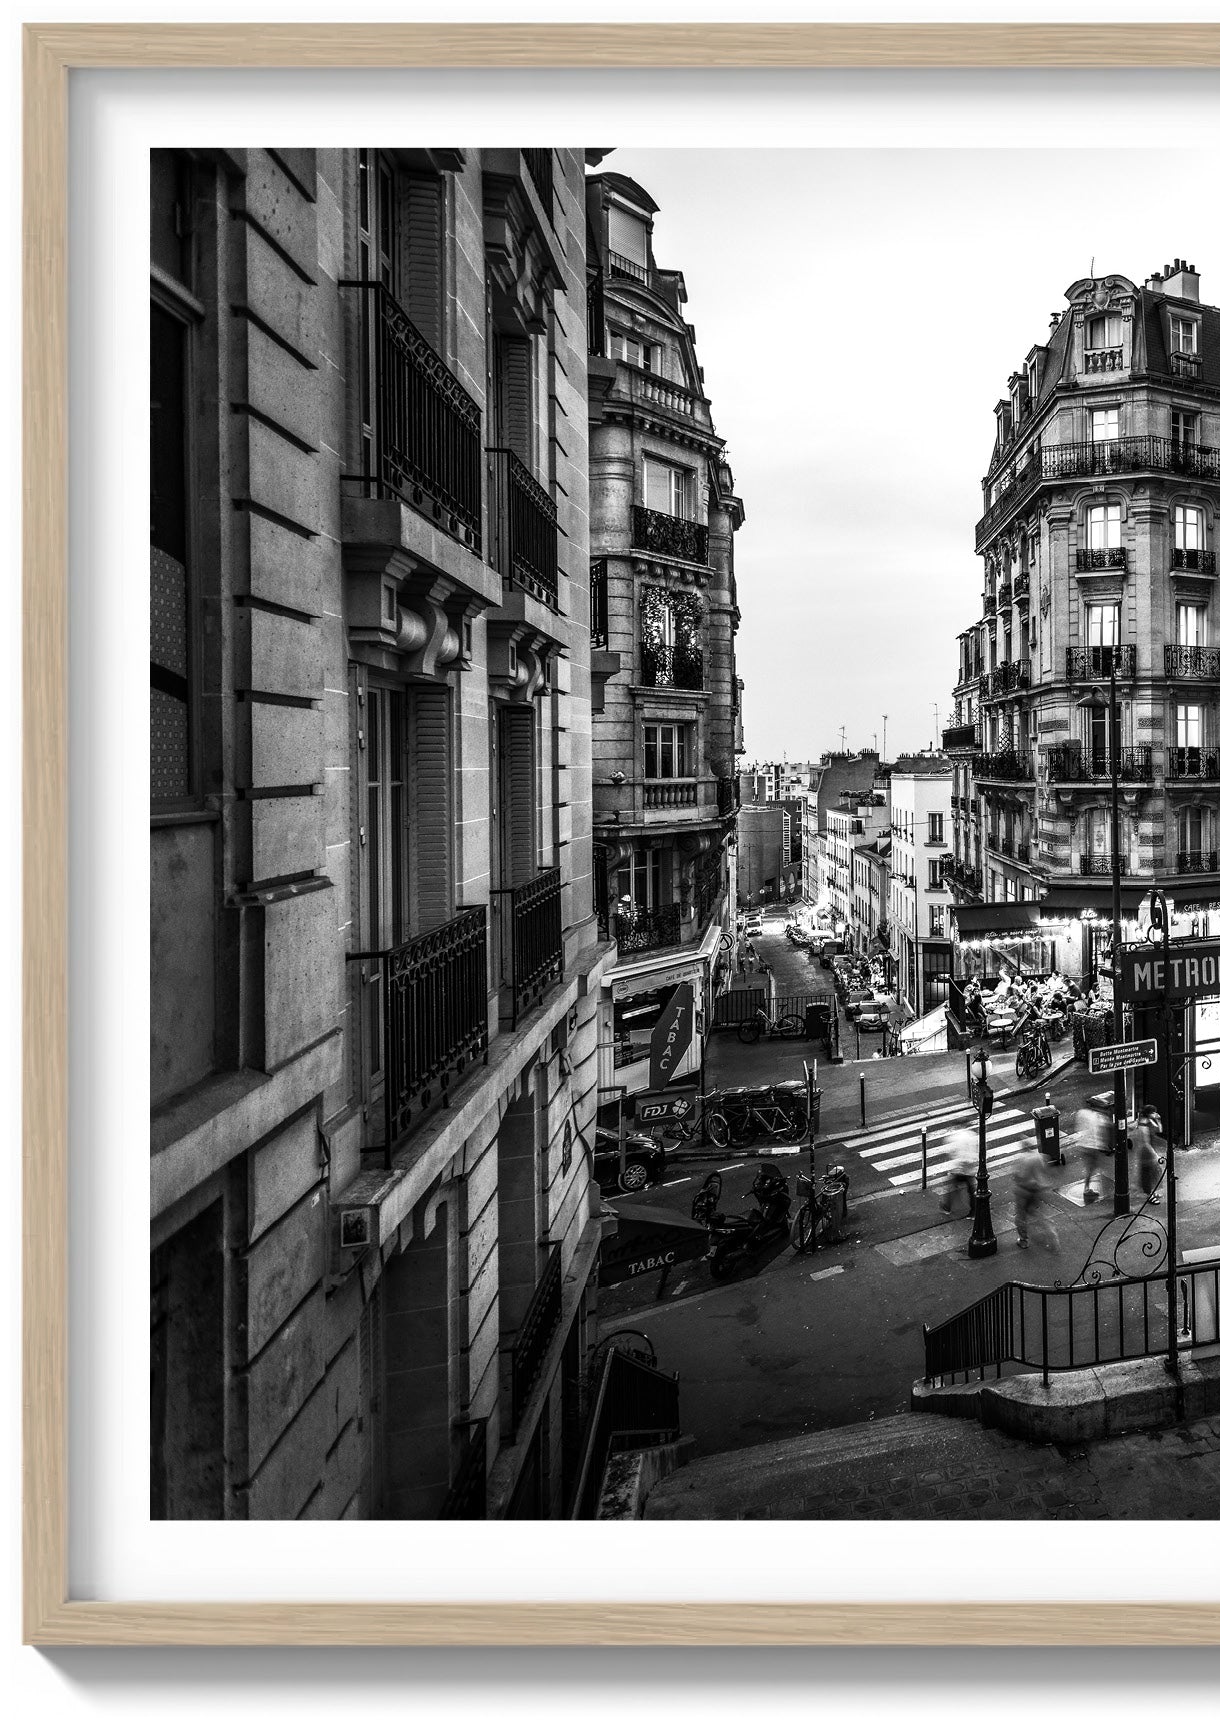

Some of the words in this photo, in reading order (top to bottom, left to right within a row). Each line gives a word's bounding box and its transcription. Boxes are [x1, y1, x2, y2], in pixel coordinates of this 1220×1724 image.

[660, 1006, 686, 1070] TABAC
[1113, 1046, 1139, 1055] Montmartre
[1116, 1052, 1141, 1060] Montmartre
[643, 1104, 668, 1118] FDJ
[628, 1251, 675, 1275] TABAC
